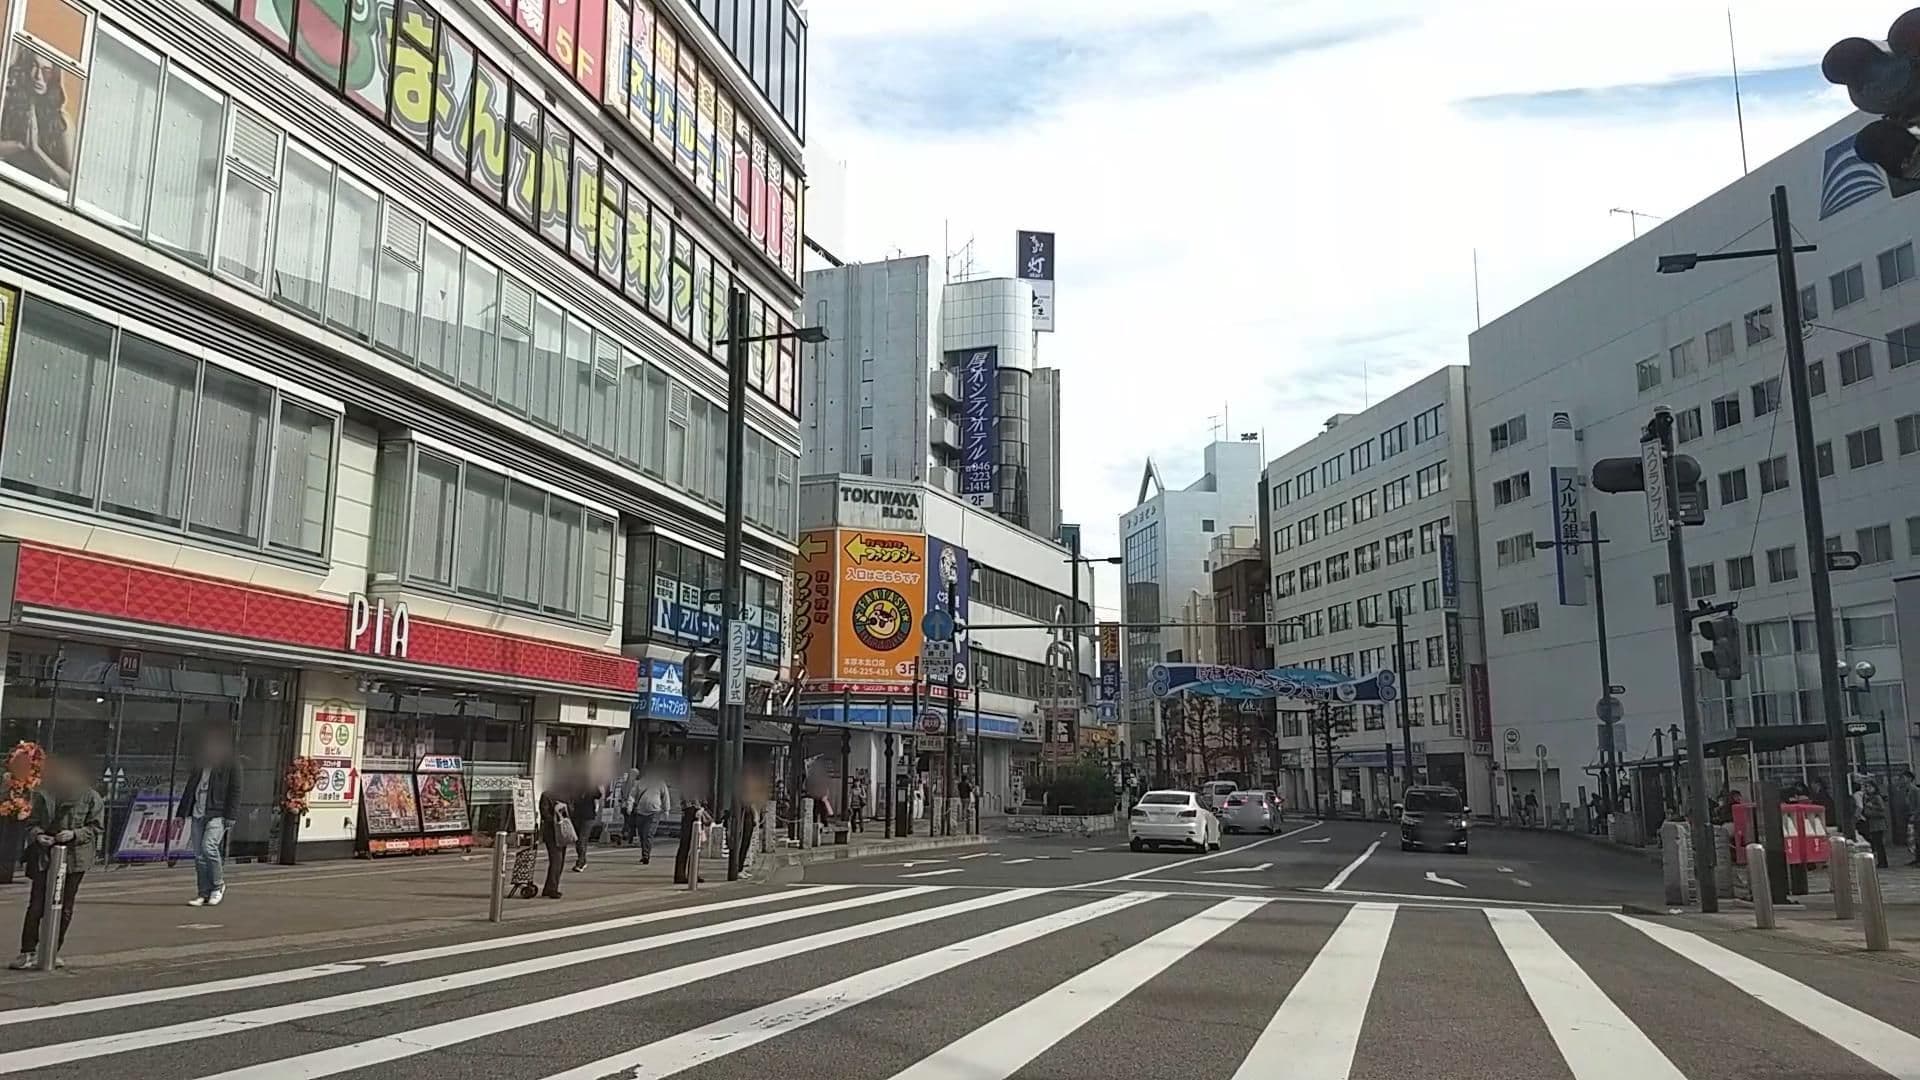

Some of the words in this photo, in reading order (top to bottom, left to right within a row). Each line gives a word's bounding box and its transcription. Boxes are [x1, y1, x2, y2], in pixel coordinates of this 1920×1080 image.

[555, 25, 595, 80] 5F
[840, 487, 919, 508] TOKIWAYA
[971, 496, 985, 506] 2F
[1647, 445, 1665, 537] スクランブル式
[882, 507, 918, 520] BLDG.
[1560, 478, 1578, 556] スルガ銀行
[864, 548, 921, 563] ファンタジー
[846, 567, 920, 584] 入口はこちらです
[858, 589, 908, 610] FANTASY
[350, 595, 409, 658] PIA
[122, 655, 138, 669] PIA
[730, 624, 743, 700] スクランブル式
[899, 664, 916, 675] 3F
